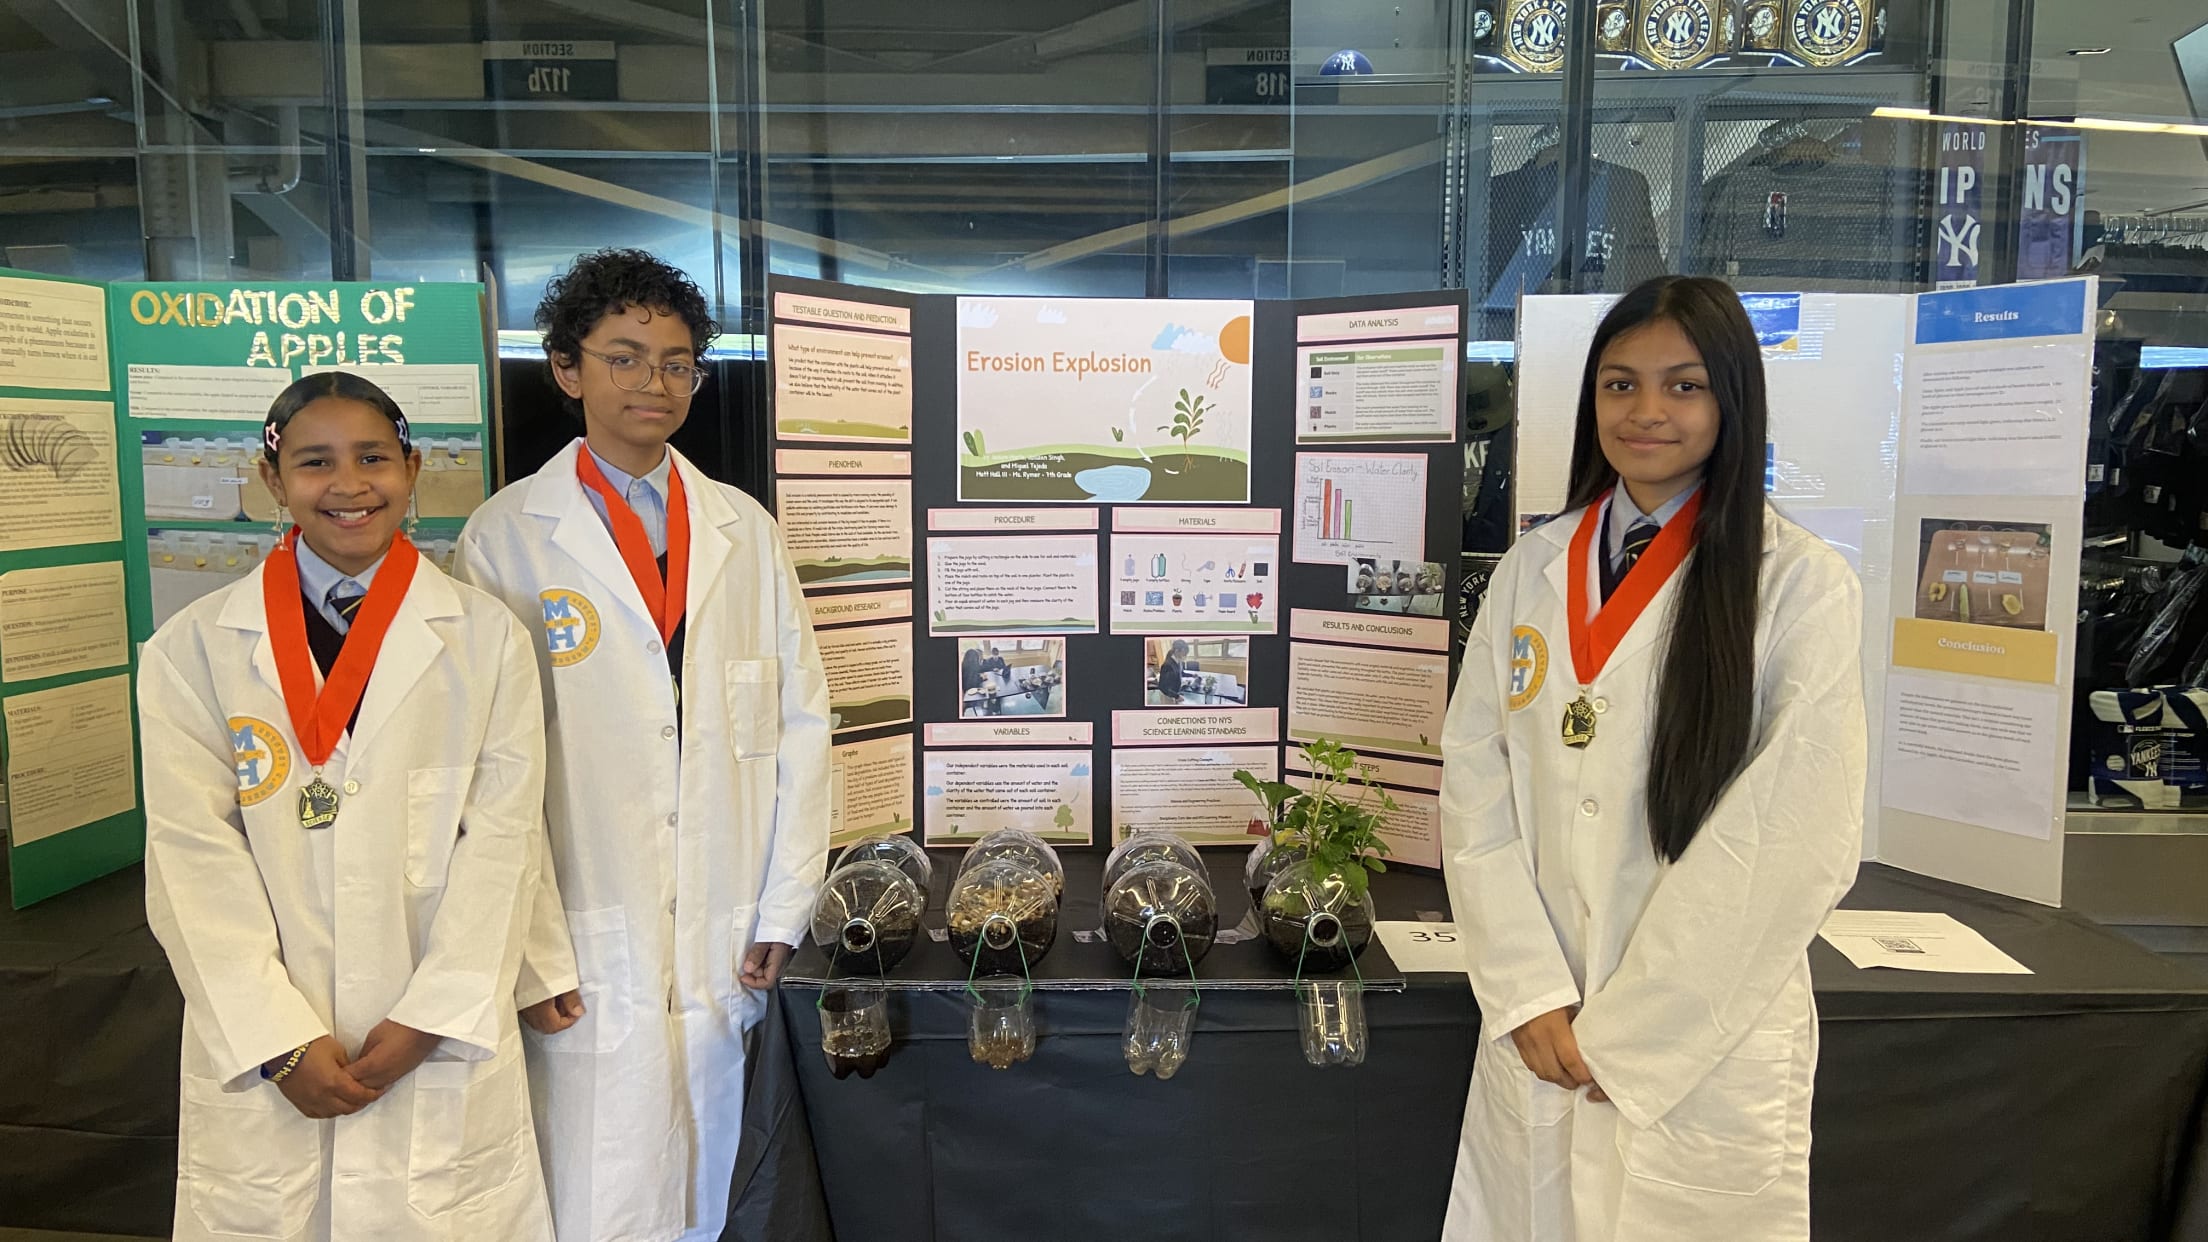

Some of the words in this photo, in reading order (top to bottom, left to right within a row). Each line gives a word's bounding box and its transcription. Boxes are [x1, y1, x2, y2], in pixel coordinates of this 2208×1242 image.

[1648, 20, 1658, 43] NEW
[1687, 0, 1708, 44] YANKEES
[1796, 18, 1808, 40] NEW
[1512, 23, 1523, 46] NEW
[1942, 130, 1986, 151] WORLD
[130, 288, 340, 329] OXIDATION
[360, 287, 415, 325] OF
[792, 305, 822, 316] TESTABLE
[823, 309, 853, 320] QUESTION
[1350, 320, 1366, 328] DATA
[1368, 319, 1399, 327] ANALYSIS
[1974, 310, 2019, 323] Results
[246, 331, 405, 368] APPLES
[968, 351, 1044, 371] Erosion
[1052, 351, 1151, 382] Explosion
[1308, 459, 1323, 473] Soil
[1366, 460, 1390, 474] Water
[1392, 463, 1418, 481] Clarity
[994, 516, 1035, 524] PROCEDURE
[1178, 518, 1216, 526] MATERIALS
[1462, 573, 1487, 594] YORK
[815, 604, 853, 615] BACKGROUND
[1459, 596, 1469, 618] NEW
[1322, 621, 1350, 630] RESULTS
[1351, 624, 1364, 632] AND
[1366, 624, 1413, 636] CONCLUSIONS
[1938, 636, 2006, 655] Conclusion
[1158, 717, 1206, 725] CONNECTIONS
[1207, 716, 1217, 724] TO
[1219, 716, 1232, 724] NYS
[994, 728, 1030, 736] VARIABLES
[1143, 728, 1172, 736] SCIENCE
[1174, 728, 1206, 736] LEARNING
[1207, 727, 1246, 735] STANDARDS
[842, 750, 858, 759] Graphs
[2130, 744, 2161, 766] YANKEES
[1360, 763, 1379, 772] STEPS
[1408, 932, 1456, 942] 35
